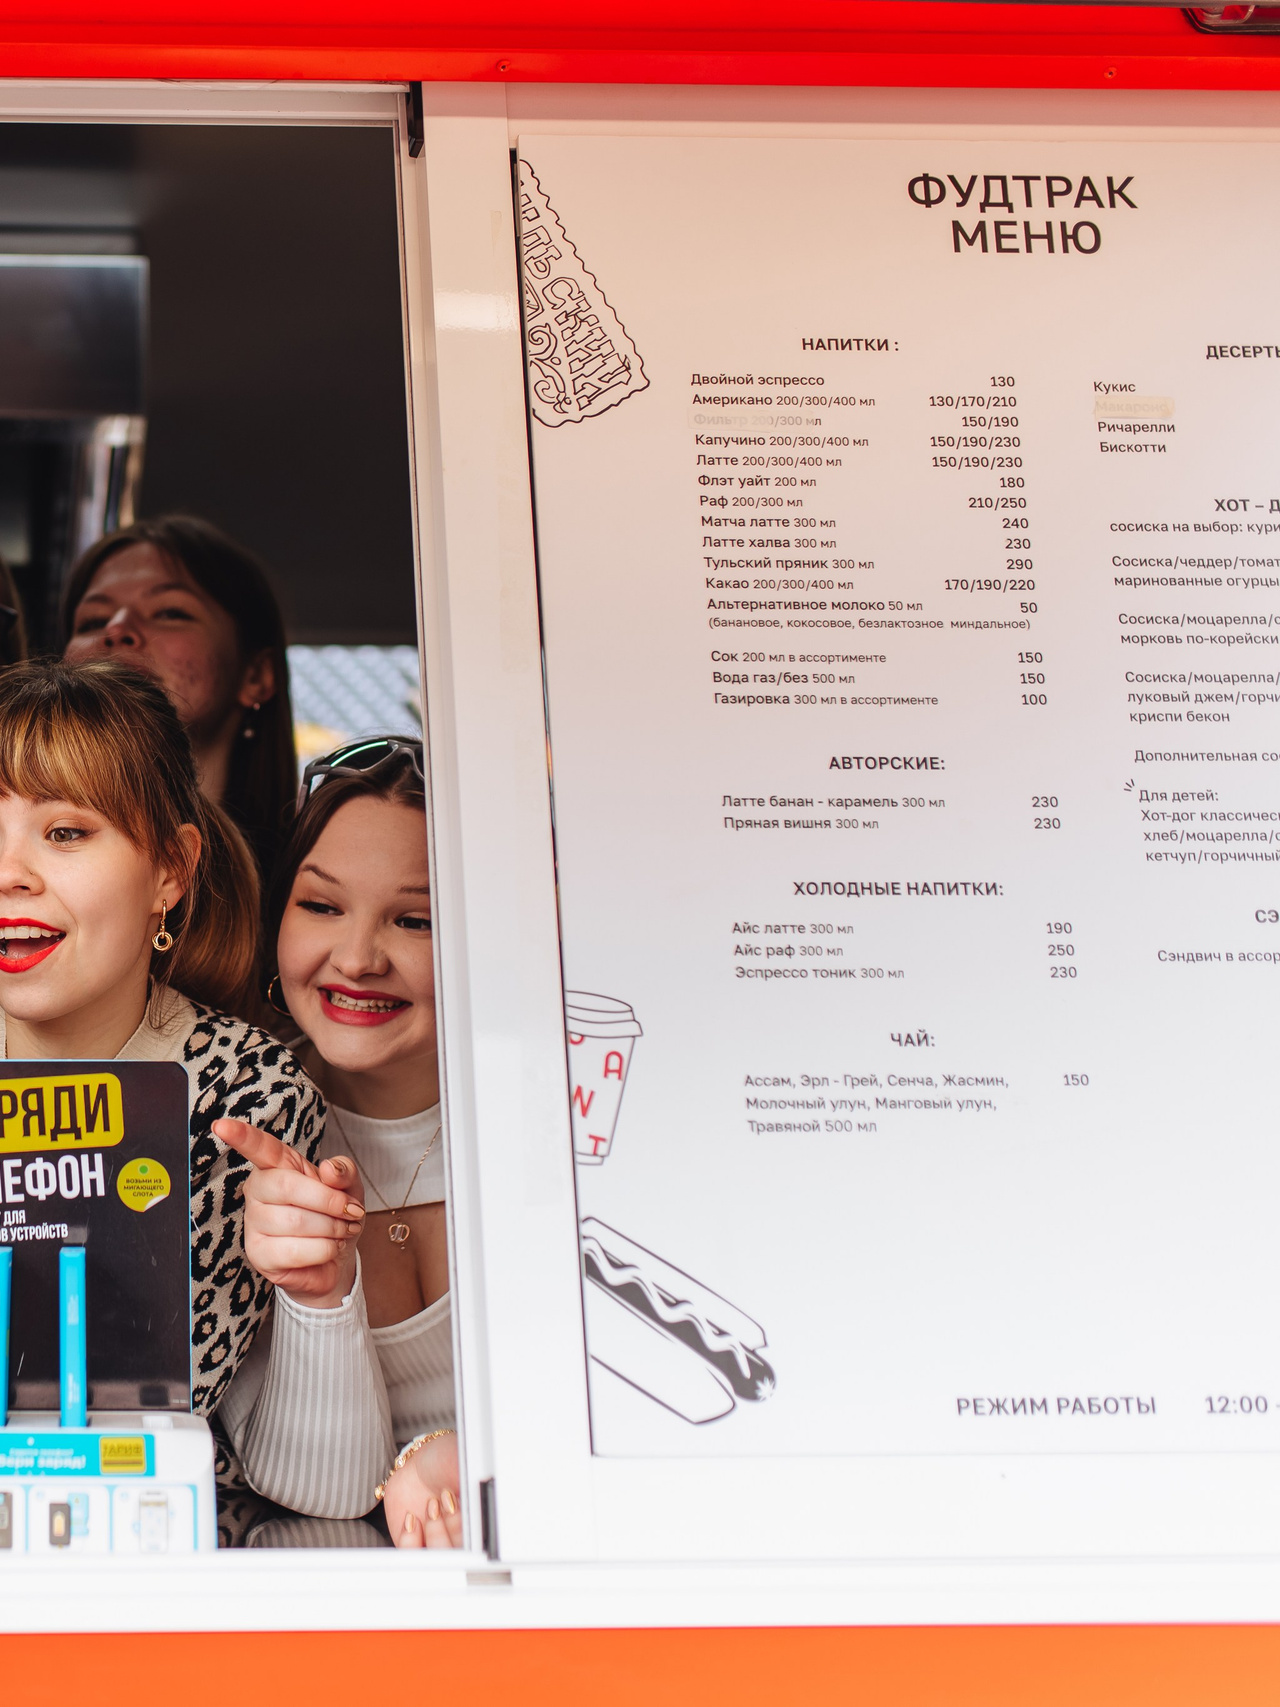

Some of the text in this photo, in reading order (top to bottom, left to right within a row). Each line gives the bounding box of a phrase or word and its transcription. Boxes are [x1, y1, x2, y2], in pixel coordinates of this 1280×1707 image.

[908, 173, 1138, 214] ФУДТРАК
[952, 220, 1101, 254] МЕНЮ
[802, 338, 889, 351] НАПИТКИ
[690, 373, 824, 388] Двойной эспрессо
[990, 376, 1015, 387] 130
[1094, 381, 1136, 395] Кукис
[692, 394, 773, 408] Американо
[776, 396, 856, 408] 200/300/400
[929, 396, 1017, 410] 130/170/210
[962, 416, 1019, 430] 150/190
[1098, 422, 1175, 435] Ричарелли
[695, 434, 766, 448] Капучино
[769, 436, 850, 448] 200/300/400
[930, 436, 1020, 450] 150/190/230
[1100, 442, 1166, 453] Бискотти
[696, 454, 738, 466] Латте
[742, 456, 822, 468] 200/300/400
[932, 456, 1022, 470] 150/190/230
[698, 474, 734, 486] Флэт
[738, 475, 771, 489] уайт
[774, 476, 797, 486] 200
[1000, 477, 1025, 488] 180
[700, 495, 728, 509] Раф
[732, 496, 784, 509] 200/300
[968, 497, 1027, 511] 210/250
[701, 516, 836, 528] Матча латте 300 мл
[1002, 518, 1029, 529] 240
[702, 536, 836, 548] Латте халва 300 мл
[1005, 538, 1031, 550] 230
[703, 556, 772, 571] Тульский
[776, 560, 828, 571] пряник
[832, 559, 855, 569] 300
[1006, 558, 1033, 570] 290
[706, 578, 854, 592] Какао 200/300/400 мл
[944, 579, 1035, 593] 170/190/220
[1114, 577, 1279, 589] маринованные огурцы
[707, 598, 827, 612] Альтернативное
[831, 601, 885, 610] молоко
[888, 601, 903, 611] 50
[1020, 602, 1038, 614] 50
[709, 617, 1030, 630] (банановое, кокосовое, безлактозное миндальное)
[1121, 632, 1279, 647] морковь по-корейски
[711, 650, 886, 664] Сок 200 мл ассортименте
[1018, 652, 1043, 663] 150
[713, 672, 749, 684] Вода
[753, 672, 809, 686] газ/без
[812, 674, 835, 684] 500
[1020, 673, 1045, 684] 150
[714, 692, 938, 707] Газировка 300 мл ассортименте
[1022, 694, 1047, 705] 100
[1130, 710, 1230, 724] криспи бекон
[829, 756, 945, 770] АВТОРСКИЕ:
[722, 795, 765, 807] Латте
[769, 795, 814, 807] банан
[828, 798, 898, 810] карамель
[902, 797, 925, 808] 300
[1032, 796, 1058, 808] 230
[1139, 789, 1218, 803] Для детей:
[724, 816, 780, 831] Пряная
[784, 820, 832, 828] вишня
[836, 818, 858, 829] 300
[1034, 818, 1061, 829] 230
[793, 882, 1003, 898] ХОЛОДНЫЕ НАПИТКИ:
[732, 922, 854, 934] Айс латте 300 мл
[1046, 922, 1072, 934] 190
[734, 944, 843, 959] Айс раф 300 мл
[1048, 944, 1075, 956] 250
[736, 966, 904, 981] Эспрессо тоник 300 мл
[1050, 966, 1077, 978] 230
[890, 1029, 934, 1046] ЧАЙ:
[745, 1074, 1008, 1089] Ассам, Эрл Грей, Сенча, Жасмин,
[1064, 1074, 1089, 1086] 150
[746, 1097, 996, 1112] Молочный улун, Манговый улун,
[747, 1120, 877, 1135] Травяной 500 мл
[4, 1209, 26, 1227] ДЛЯ
[10, 1221, 69, 1242] УСТРОЙСТВ
[957, 1397, 1156, 1415] РЕЖИМ РАБОТЫ
[1206, 1396, 1268, 1413] 12:00
